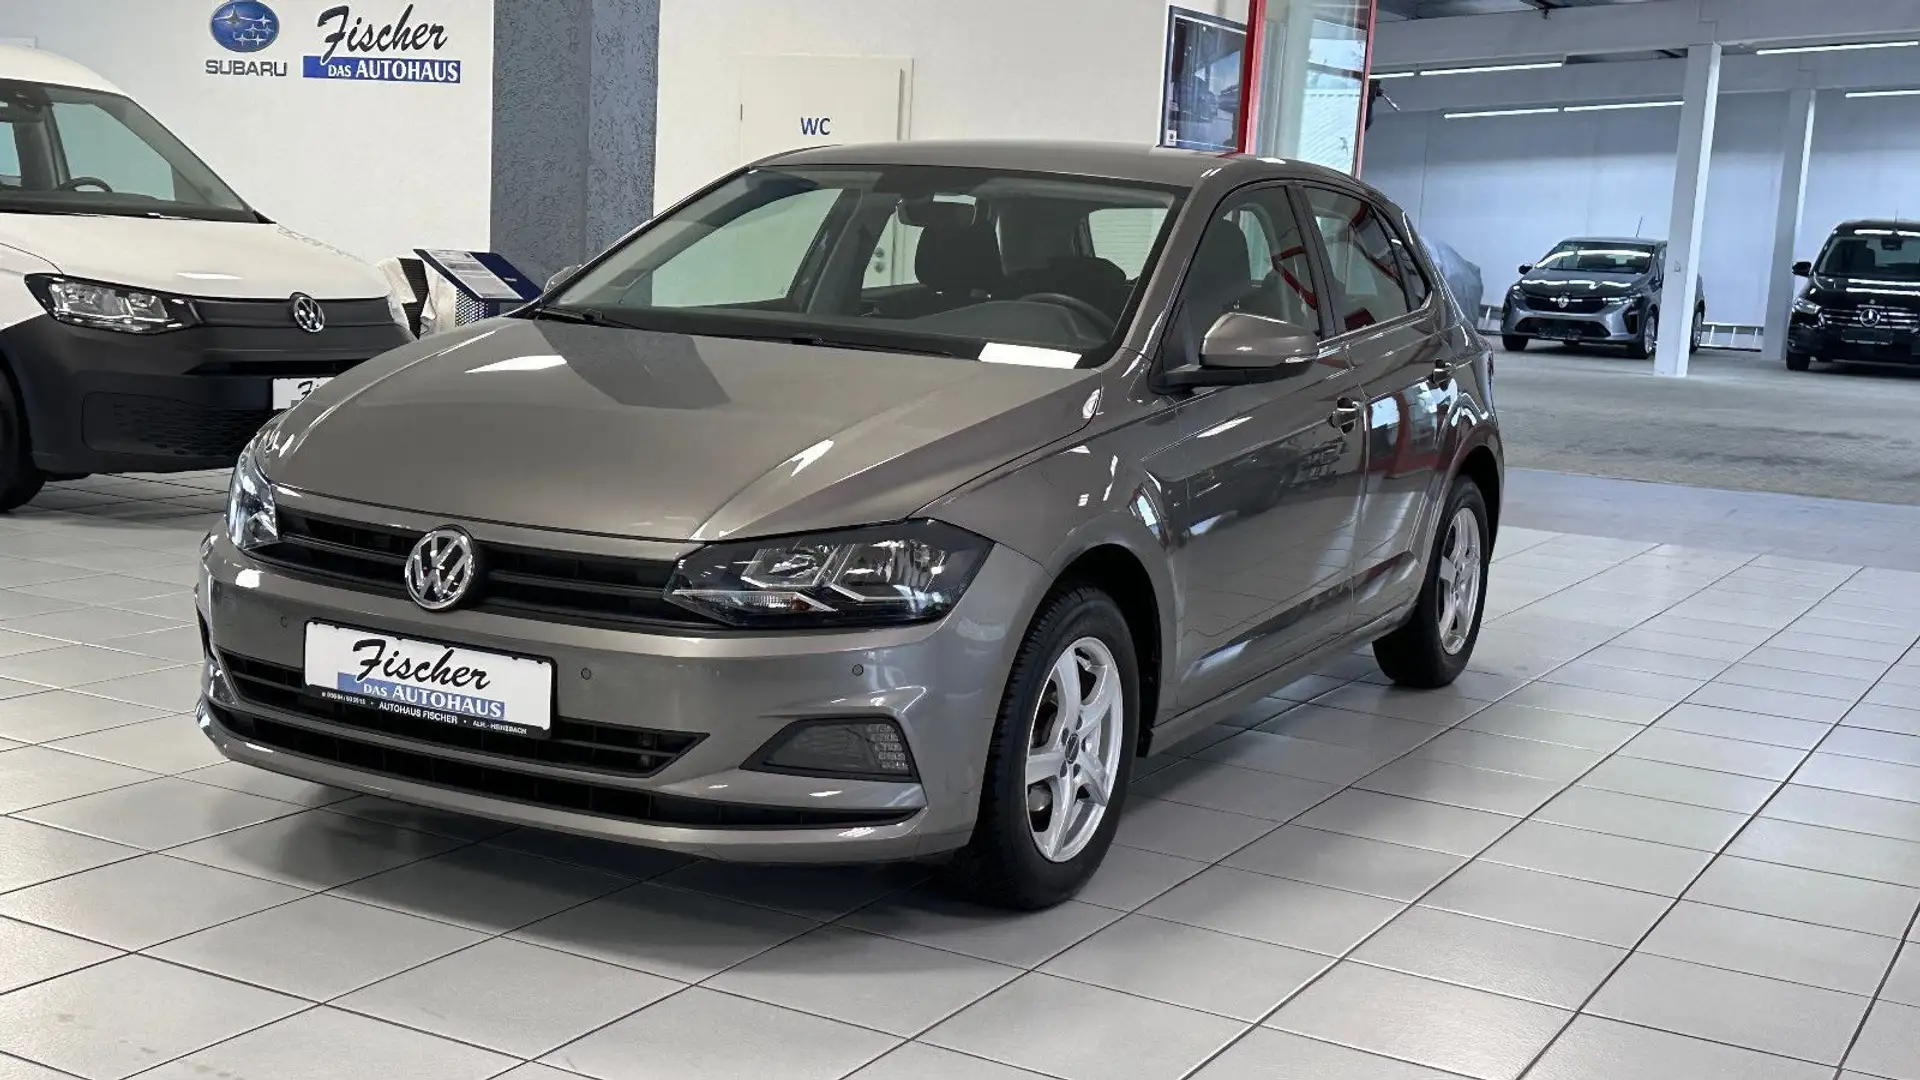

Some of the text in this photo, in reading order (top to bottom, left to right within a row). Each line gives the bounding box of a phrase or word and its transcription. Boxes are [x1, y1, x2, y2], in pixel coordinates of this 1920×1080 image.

[317, 4, 448, 64] Fischer
[205, 59, 287, 77] SUBARU
[328, 60, 459, 82] DAS AUTOHAUS
[800, 117, 830, 136] WC
[352, 639, 491, 690] Fischer
[363, 682, 388, 697] DAS
[392, 685, 502, 718] AUTOHAUS
[378, 701, 458, 725] AUTOHAUS FISCHER
